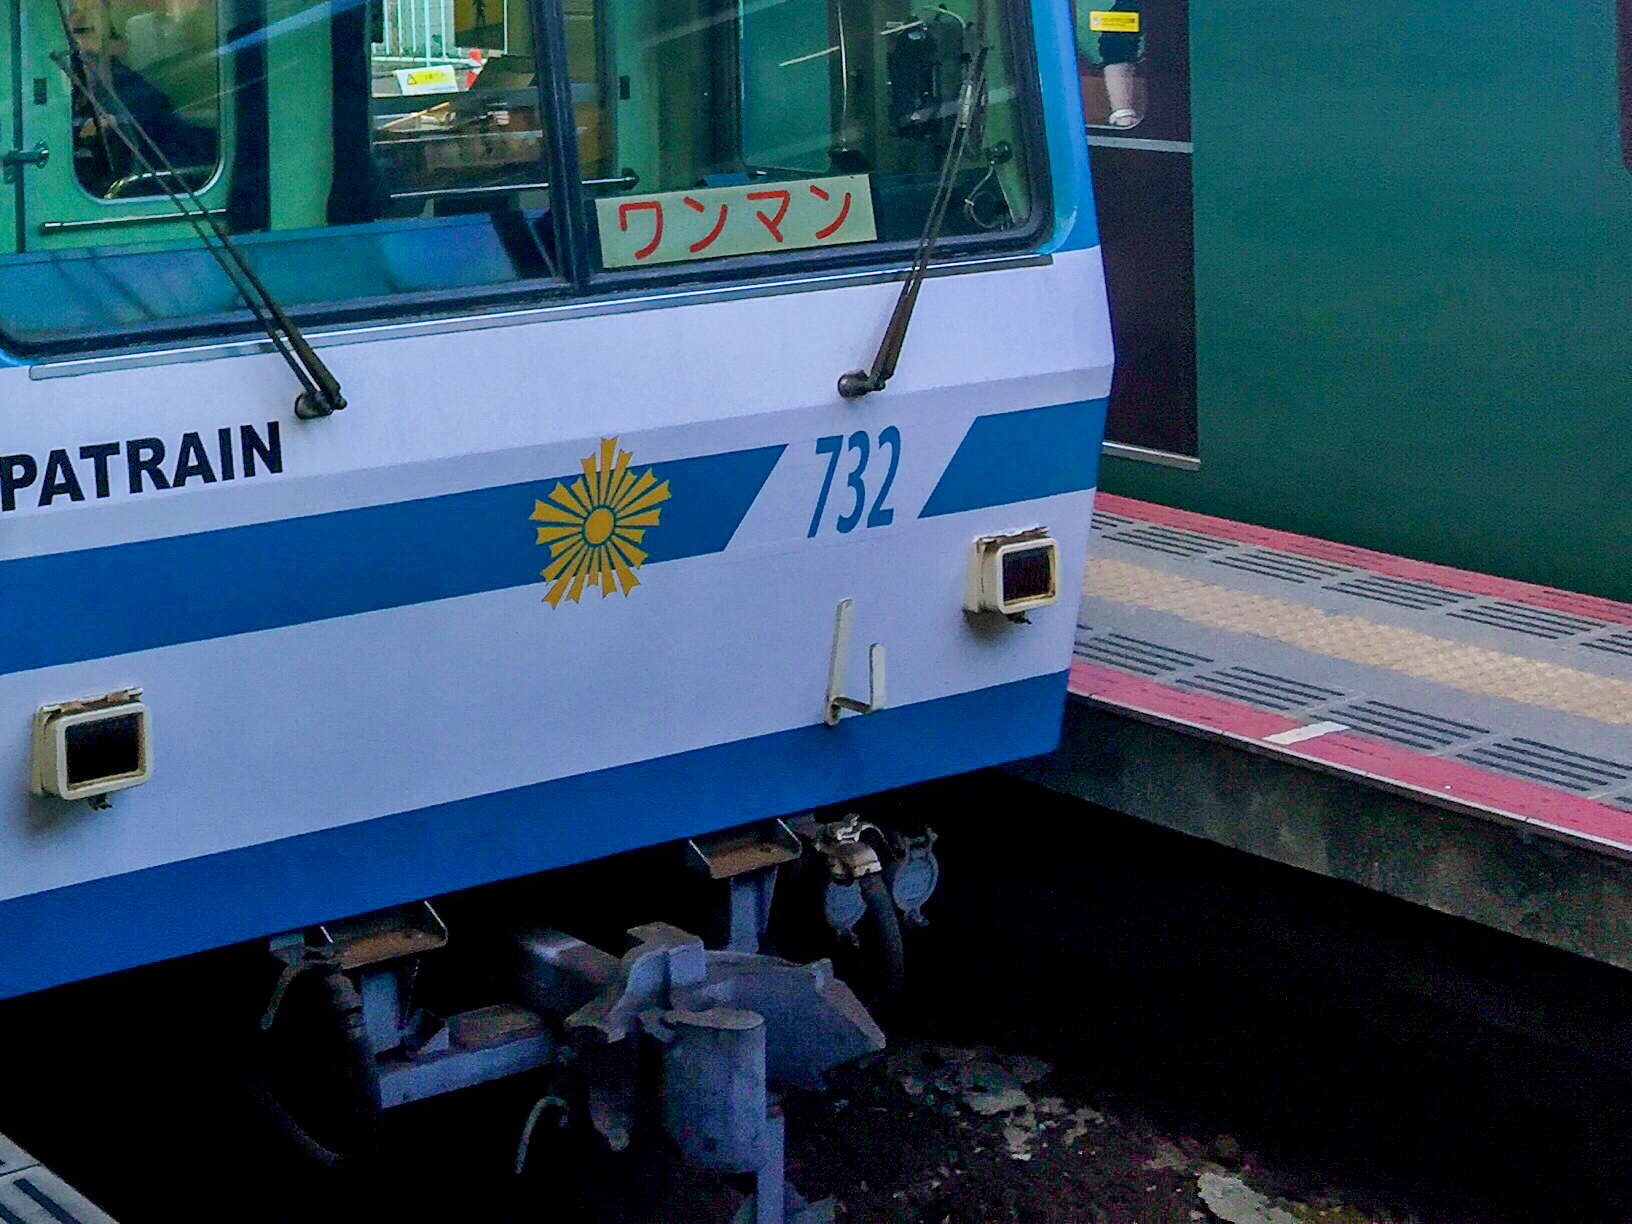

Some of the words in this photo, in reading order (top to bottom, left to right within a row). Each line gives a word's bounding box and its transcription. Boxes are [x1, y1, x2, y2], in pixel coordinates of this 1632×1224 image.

[618, 185, 853, 261] ワンマン
[806, 424, 903, 538] 732
